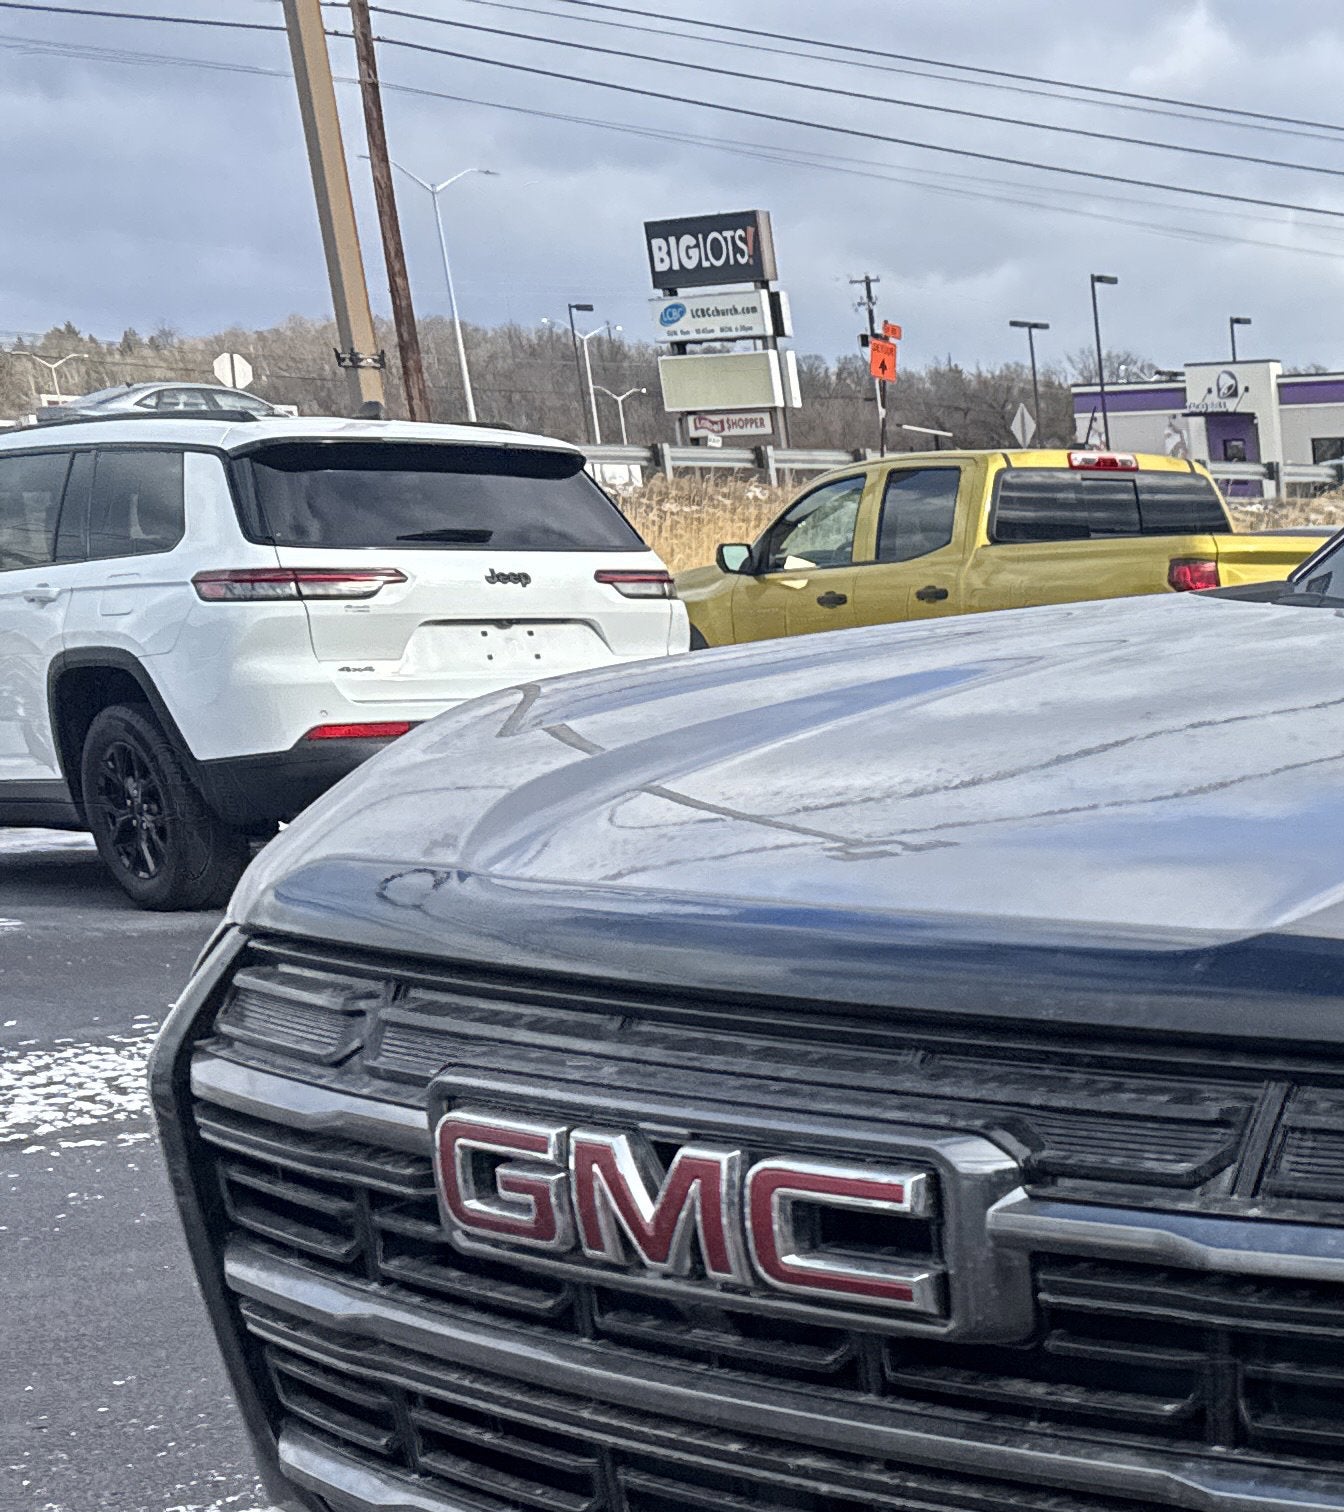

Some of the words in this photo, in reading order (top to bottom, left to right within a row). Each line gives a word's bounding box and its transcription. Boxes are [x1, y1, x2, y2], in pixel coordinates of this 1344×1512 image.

[690, 305, 758, 319] LCBCchurch.com
[727, 417, 766, 432] $HOPPER
[484, 567, 532, 588] Jeep
[434, 1107, 944, 1315] GMC
